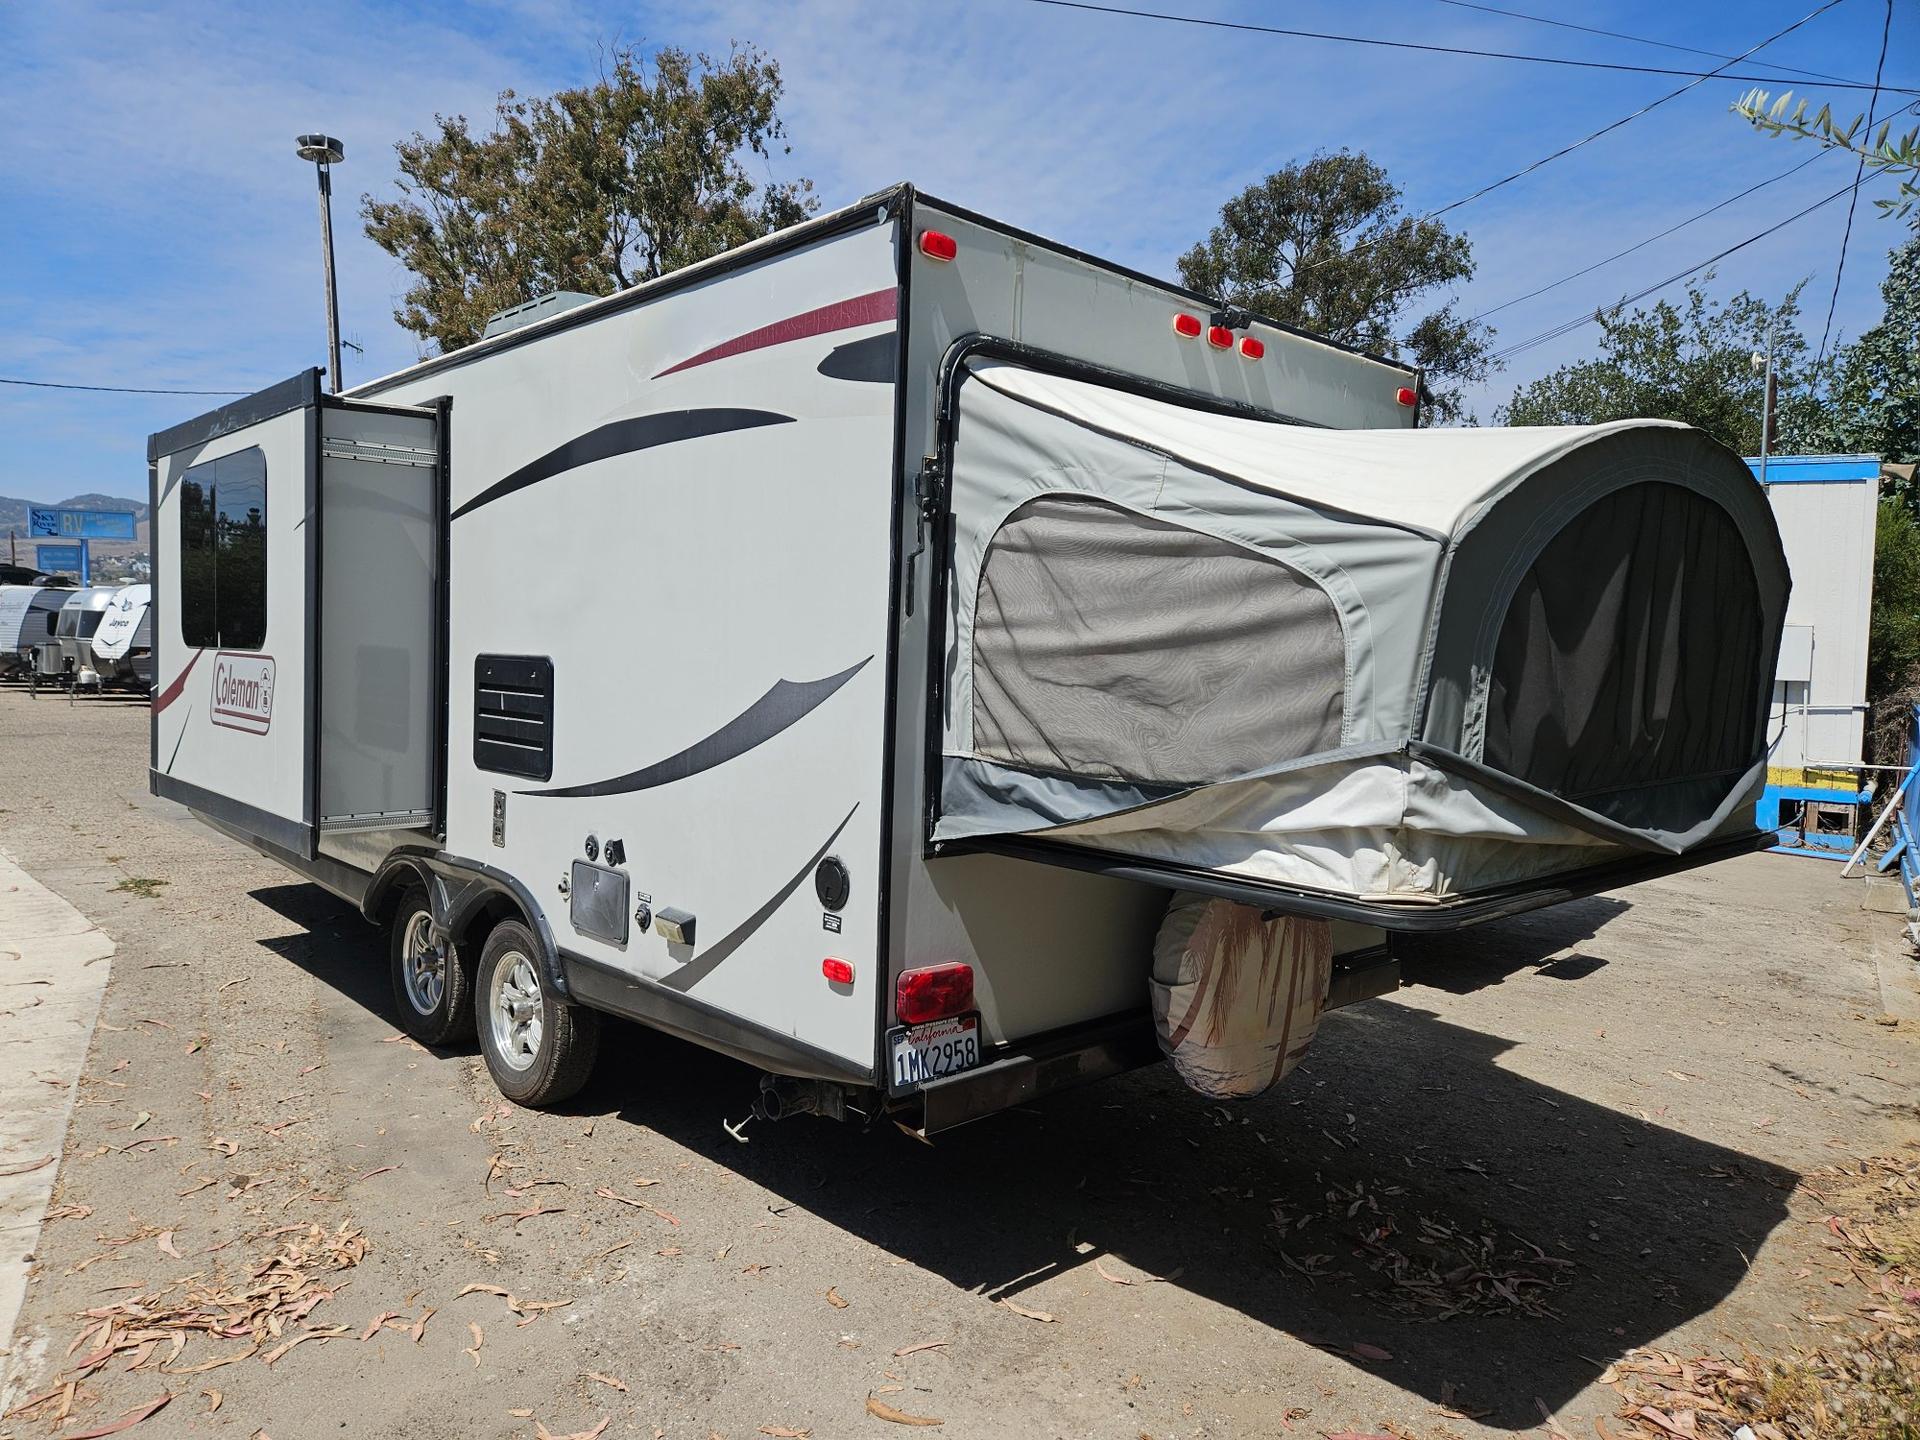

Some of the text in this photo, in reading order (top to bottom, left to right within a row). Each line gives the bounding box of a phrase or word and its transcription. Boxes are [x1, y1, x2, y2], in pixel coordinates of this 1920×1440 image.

[63, 513, 83, 533] RV
[109, 618, 129, 629] Jayco
[216, 662, 259, 710] Coleman
[908, 1024, 964, 1046] California
[897, 1037, 975, 1085] 1MK2958
